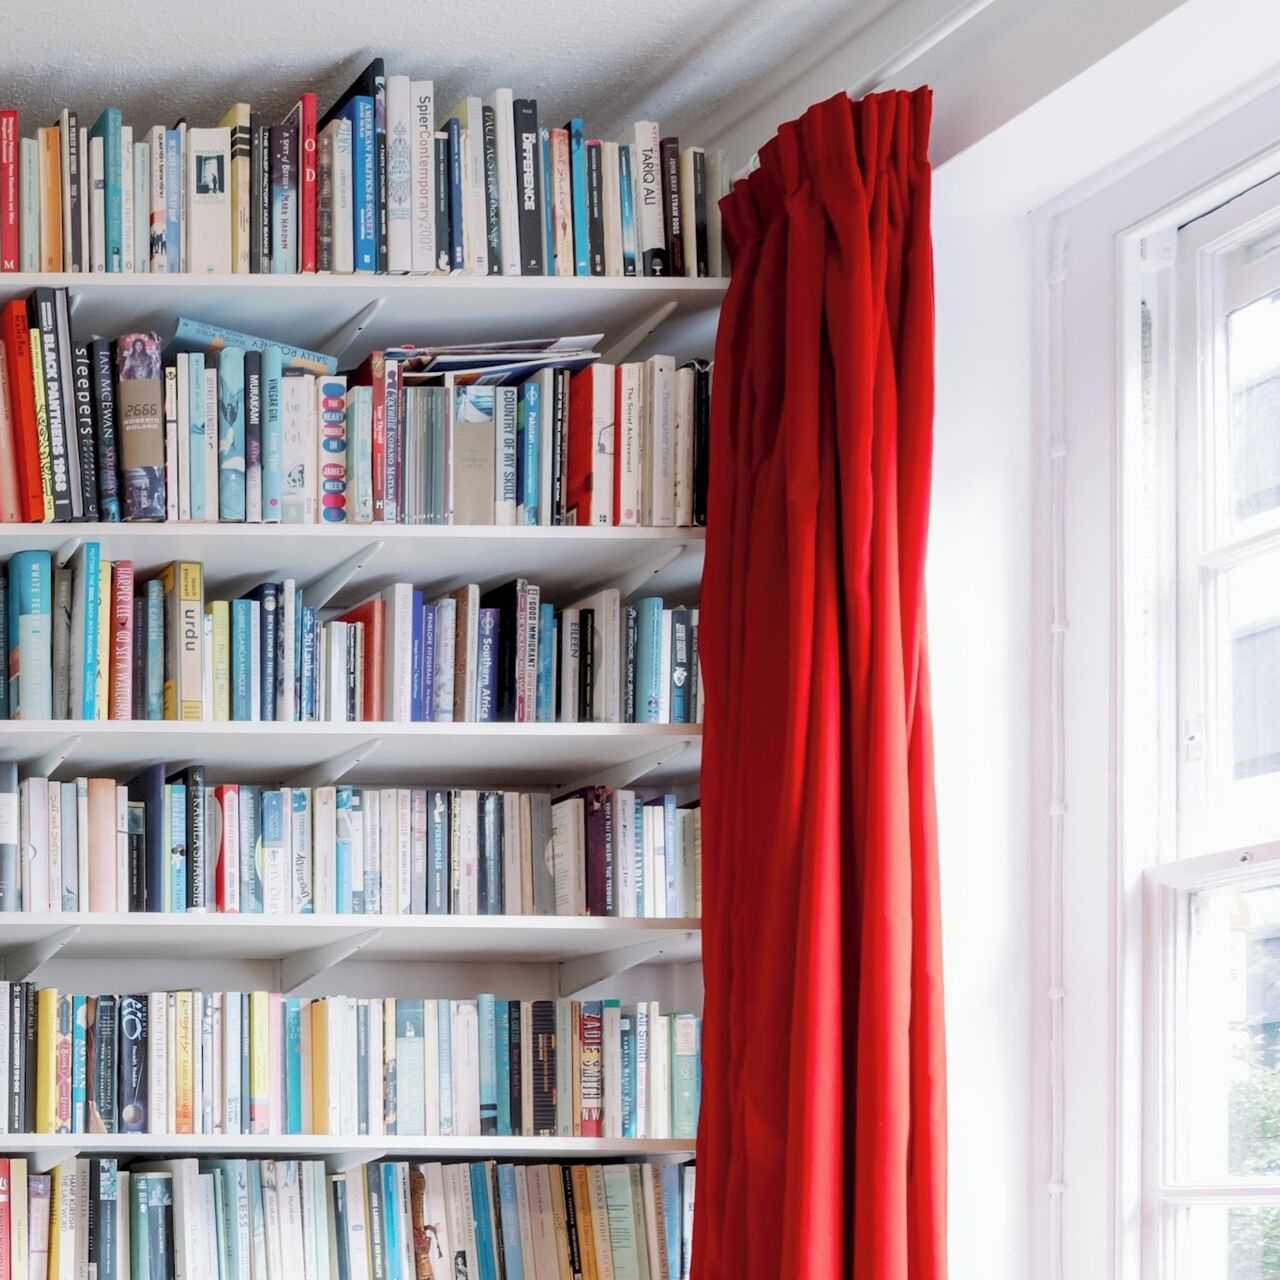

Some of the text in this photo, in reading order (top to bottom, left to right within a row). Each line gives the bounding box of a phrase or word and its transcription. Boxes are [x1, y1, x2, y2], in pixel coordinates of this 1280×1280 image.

[364, 103, 373, 150] AMERICAN
[365, 154, 373, 194] POLITICS
[642, 148, 656, 206] TARIQ ALI
[669, 158, 677, 174] JOHN
[365, 203, 374, 239] SOCIETY
[671, 194, 679, 216] STRAW
[99, 351, 110, 374] IAN
[43, 334, 66, 491] BLACK PANTHERS 1968
[75, 348, 93, 435] sleepers
[125, 404, 157, 418] 2666
[249, 375, 259, 425] MURAKAMI
[268, 379, 278, 423] VINEGAR GIRL
[503, 390, 515, 502] COUNTRY OF MY SKULL
[528, 412, 536, 443] Pakistan
[626, 427, 634, 473] Achievement
[32, 563, 40, 592] WHITE
[117, 567, 131, 602] HARPER
[116, 605, 129, 618] LEE
[185, 609, 197, 651] urdu
[117, 630, 129, 642] GO
[304, 632, 314, 677] Sri Lanka
[528, 623, 536, 668] IMMIGRANT
[571, 623, 579, 658] EILEEN
[481, 638, 492, 719] Southern Africa
[193, 799, 202, 905] KAMILA SHAMSIE
[583, 1013, 601, 1100] ZADIE SMITH
[639, 1012, 648, 1063] Ali Smith
[238, 1196, 248, 1228] LESS
